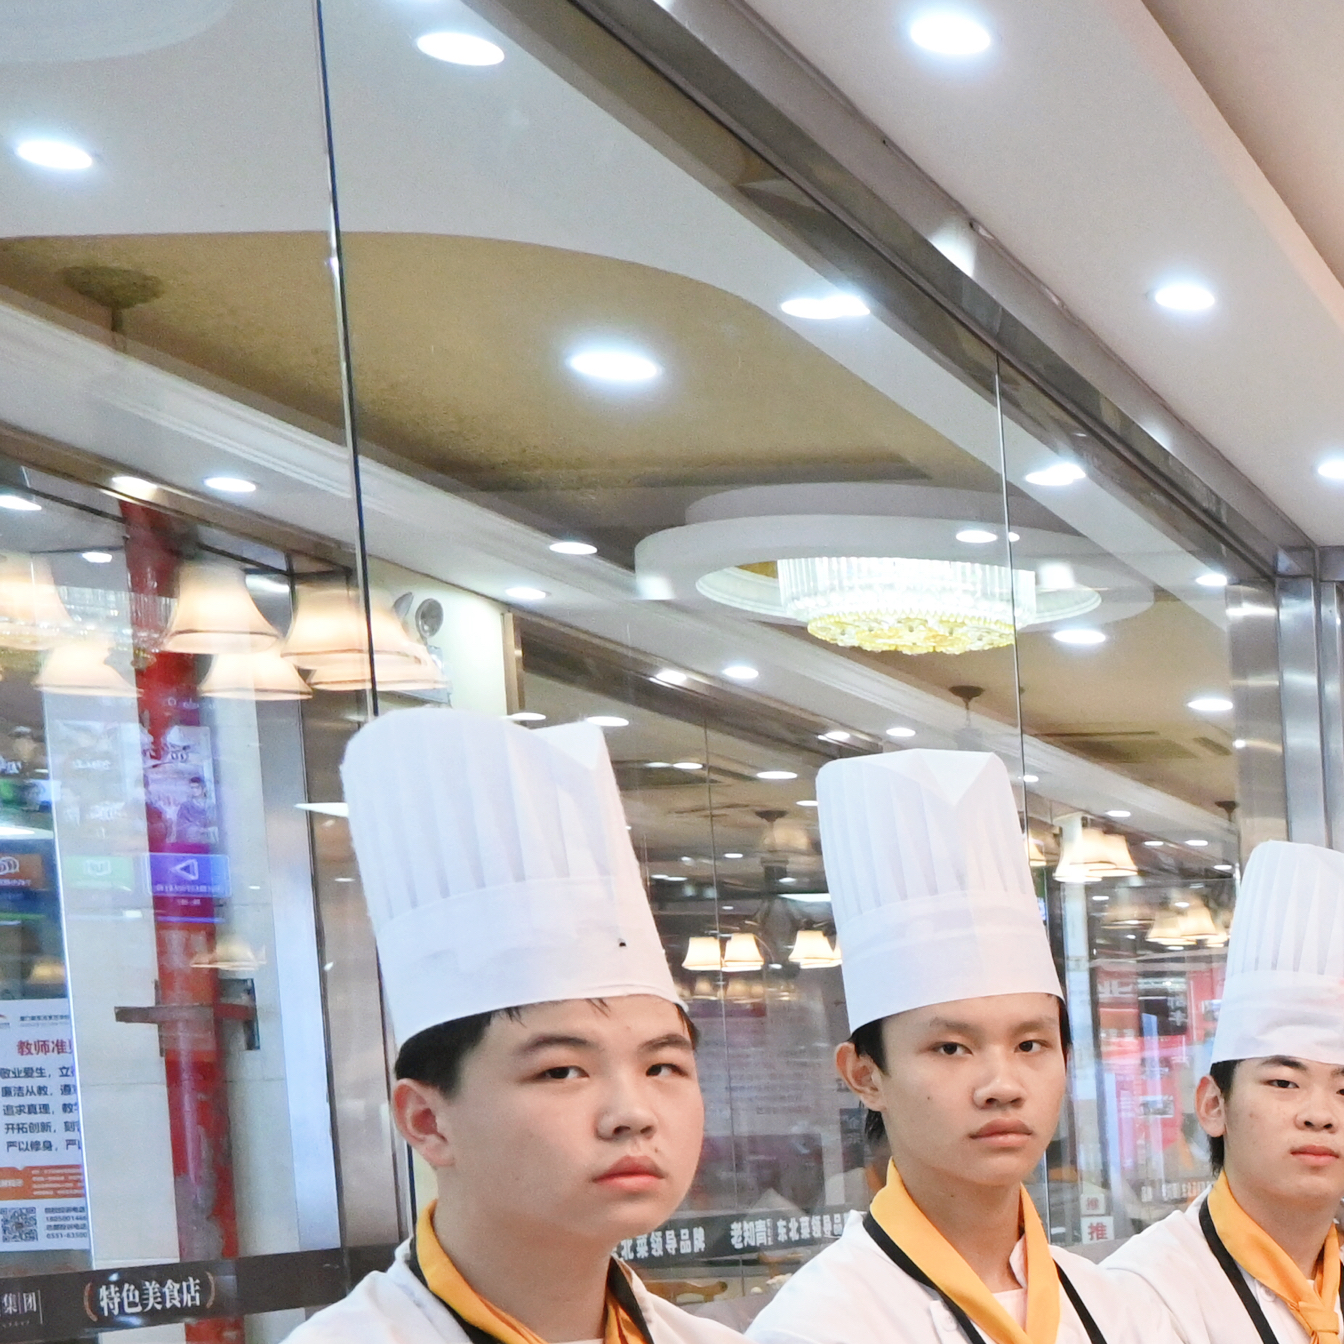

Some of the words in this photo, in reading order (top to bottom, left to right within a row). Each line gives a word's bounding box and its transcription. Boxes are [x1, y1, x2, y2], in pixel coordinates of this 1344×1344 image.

[611, 1226, 706, 1262] 北菜领导品牌
[99, 1275, 202, 1318] 特色美食店
